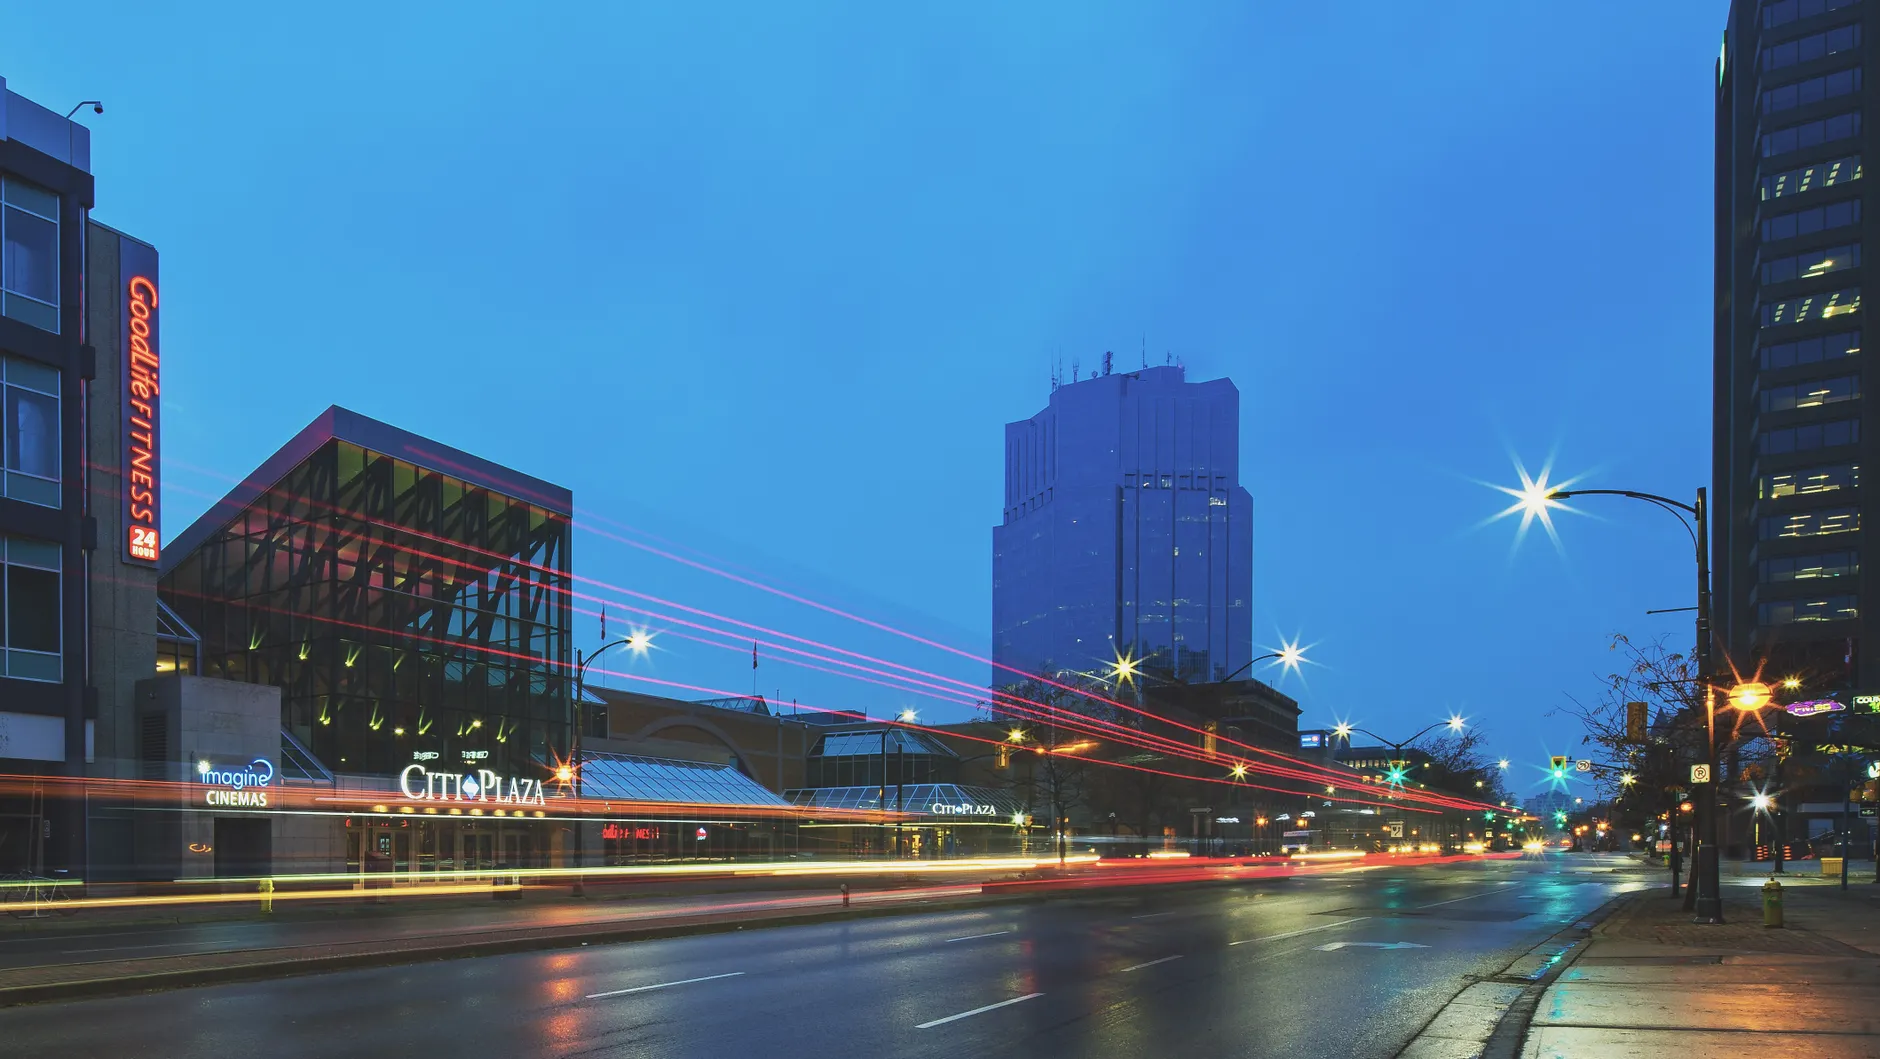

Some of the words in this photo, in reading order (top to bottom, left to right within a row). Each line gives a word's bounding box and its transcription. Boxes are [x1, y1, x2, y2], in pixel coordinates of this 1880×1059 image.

[130, 398, 154, 524] FITNESS
[132, 528, 156, 548] 24
[132, 545, 155, 559] HOUR
[197, 759, 273, 790] imagine
[206, 789, 267, 807] CINEMAS
[478, 769, 546, 806] PLAZA
